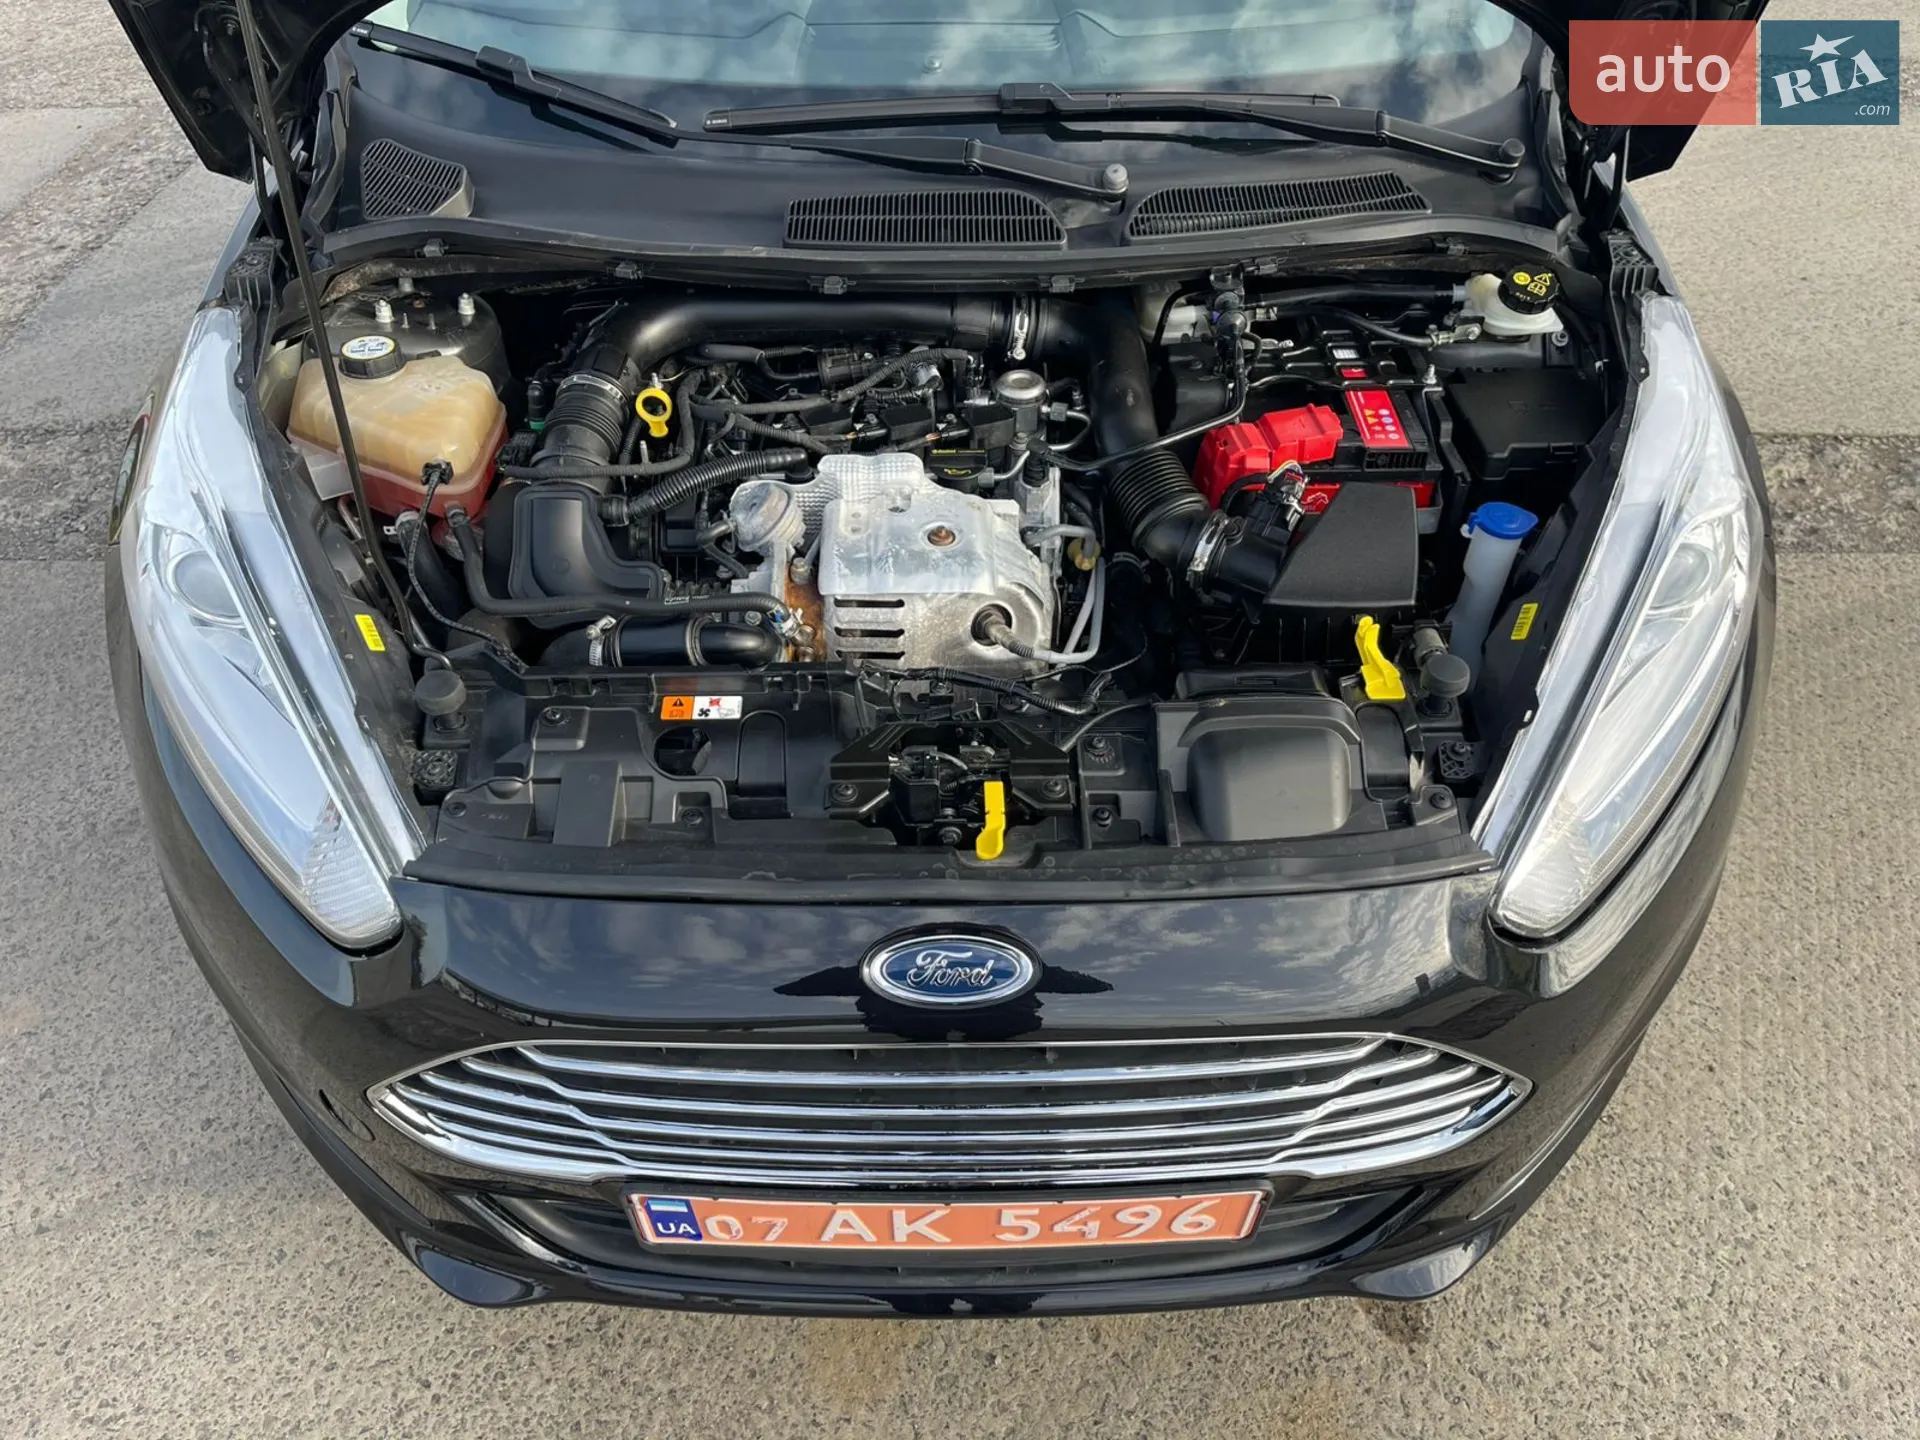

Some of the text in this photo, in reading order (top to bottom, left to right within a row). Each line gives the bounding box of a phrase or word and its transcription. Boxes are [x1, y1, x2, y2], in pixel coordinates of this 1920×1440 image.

[906, 950, 995, 987] Ford
[656, 1222, 697, 1235] UA
[704, 1198, 1222, 1243] 07 AK 5496
